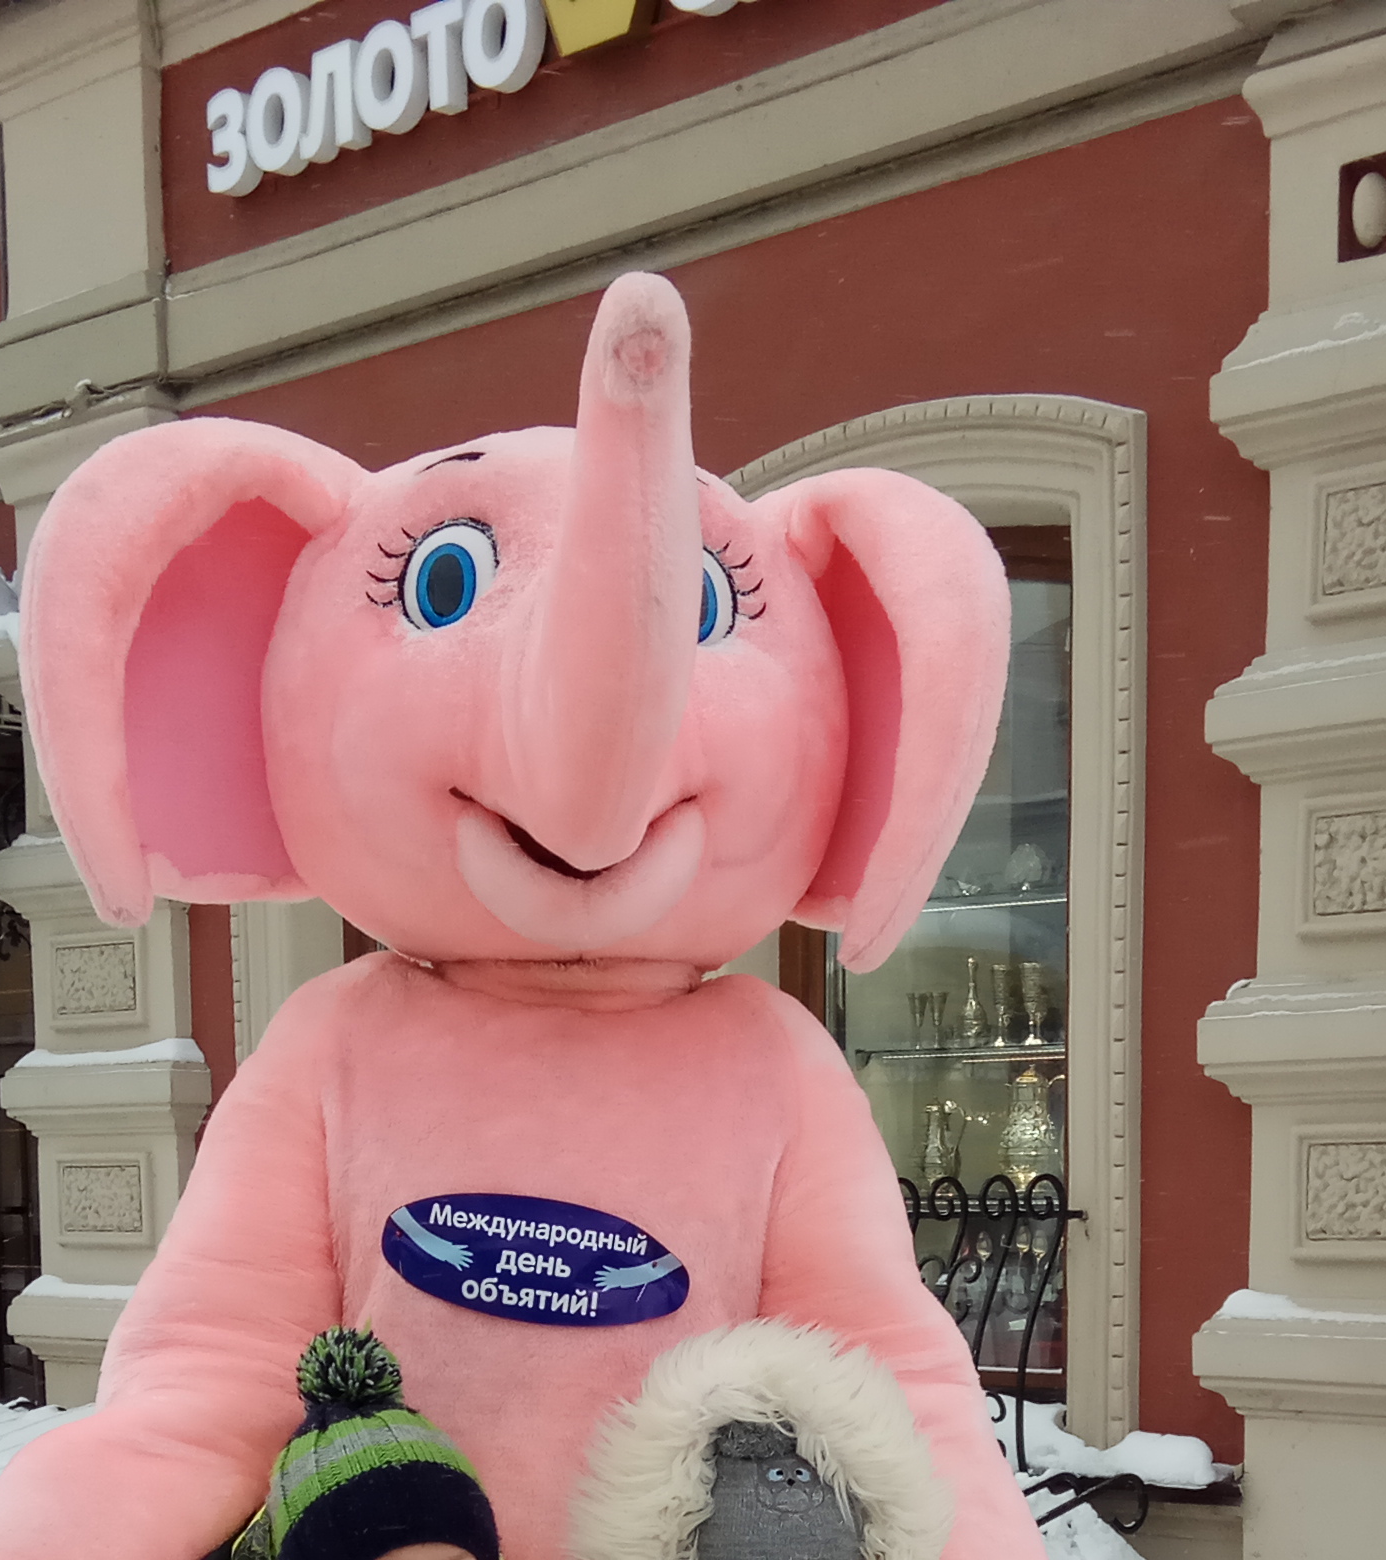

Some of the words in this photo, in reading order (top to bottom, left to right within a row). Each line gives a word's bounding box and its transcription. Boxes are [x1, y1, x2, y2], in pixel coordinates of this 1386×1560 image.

[206, 0, 546, 198] ЗОЛОТО
[428, 1202, 648, 1257] Международный
[495, 1248, 572, 1279] день
[461, 1278, 600, 1318] объятий!
